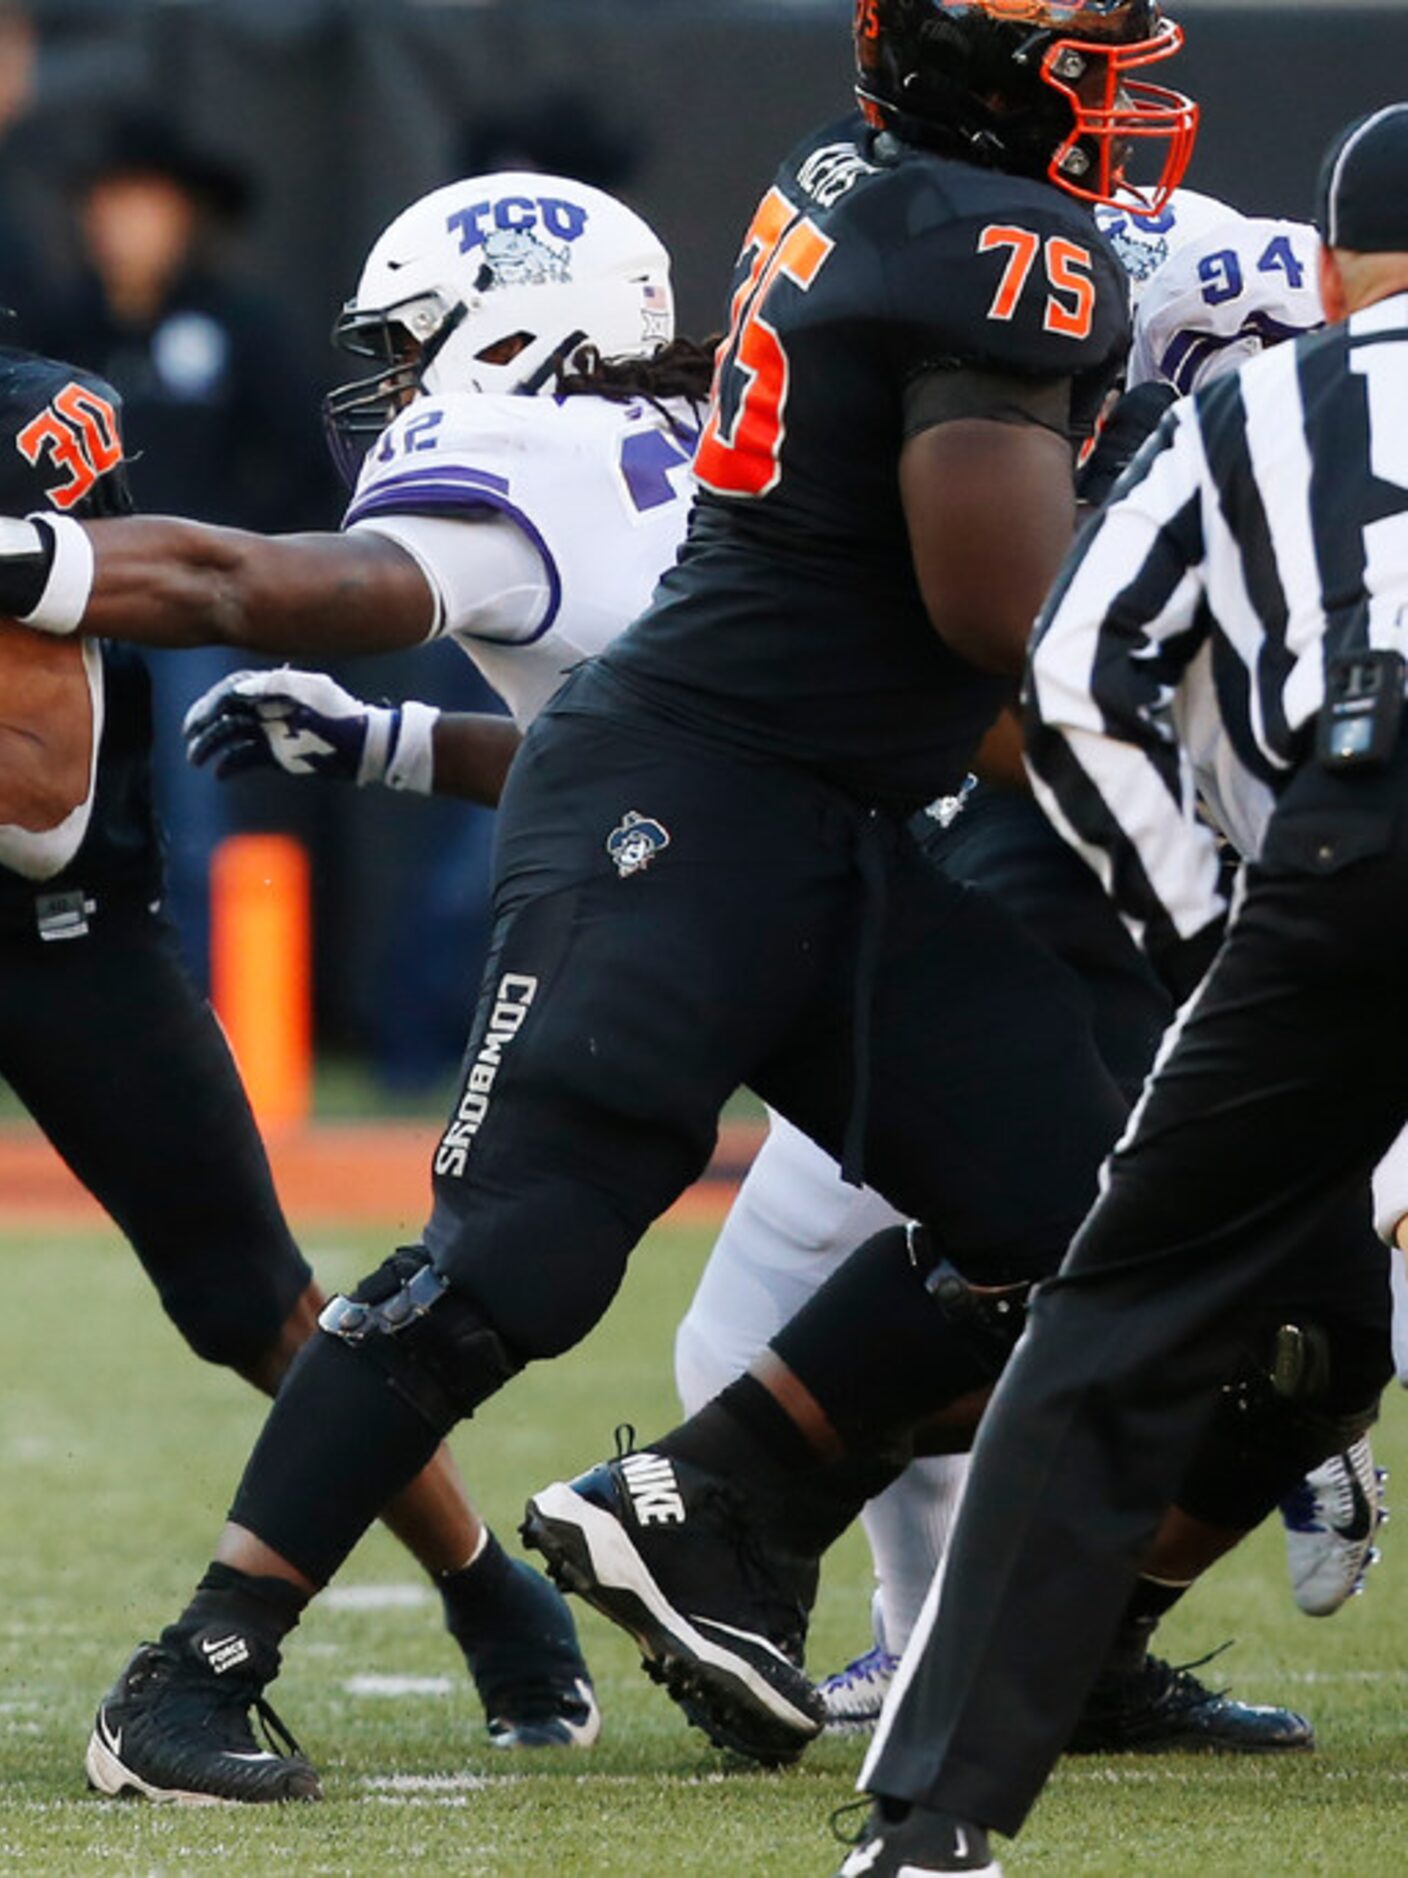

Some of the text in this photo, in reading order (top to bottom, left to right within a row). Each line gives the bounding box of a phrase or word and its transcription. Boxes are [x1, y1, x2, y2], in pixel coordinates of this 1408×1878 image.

[446, 197, 589, 255] TCU
[1198, 236, 1306, 306] 94
[976, 225, 1096, 340] 75
[16, 378, 124, 509] 30
[434, 973, 537, 1177] COWBOYS
[621, 1453, 686, 1526] NIKE
